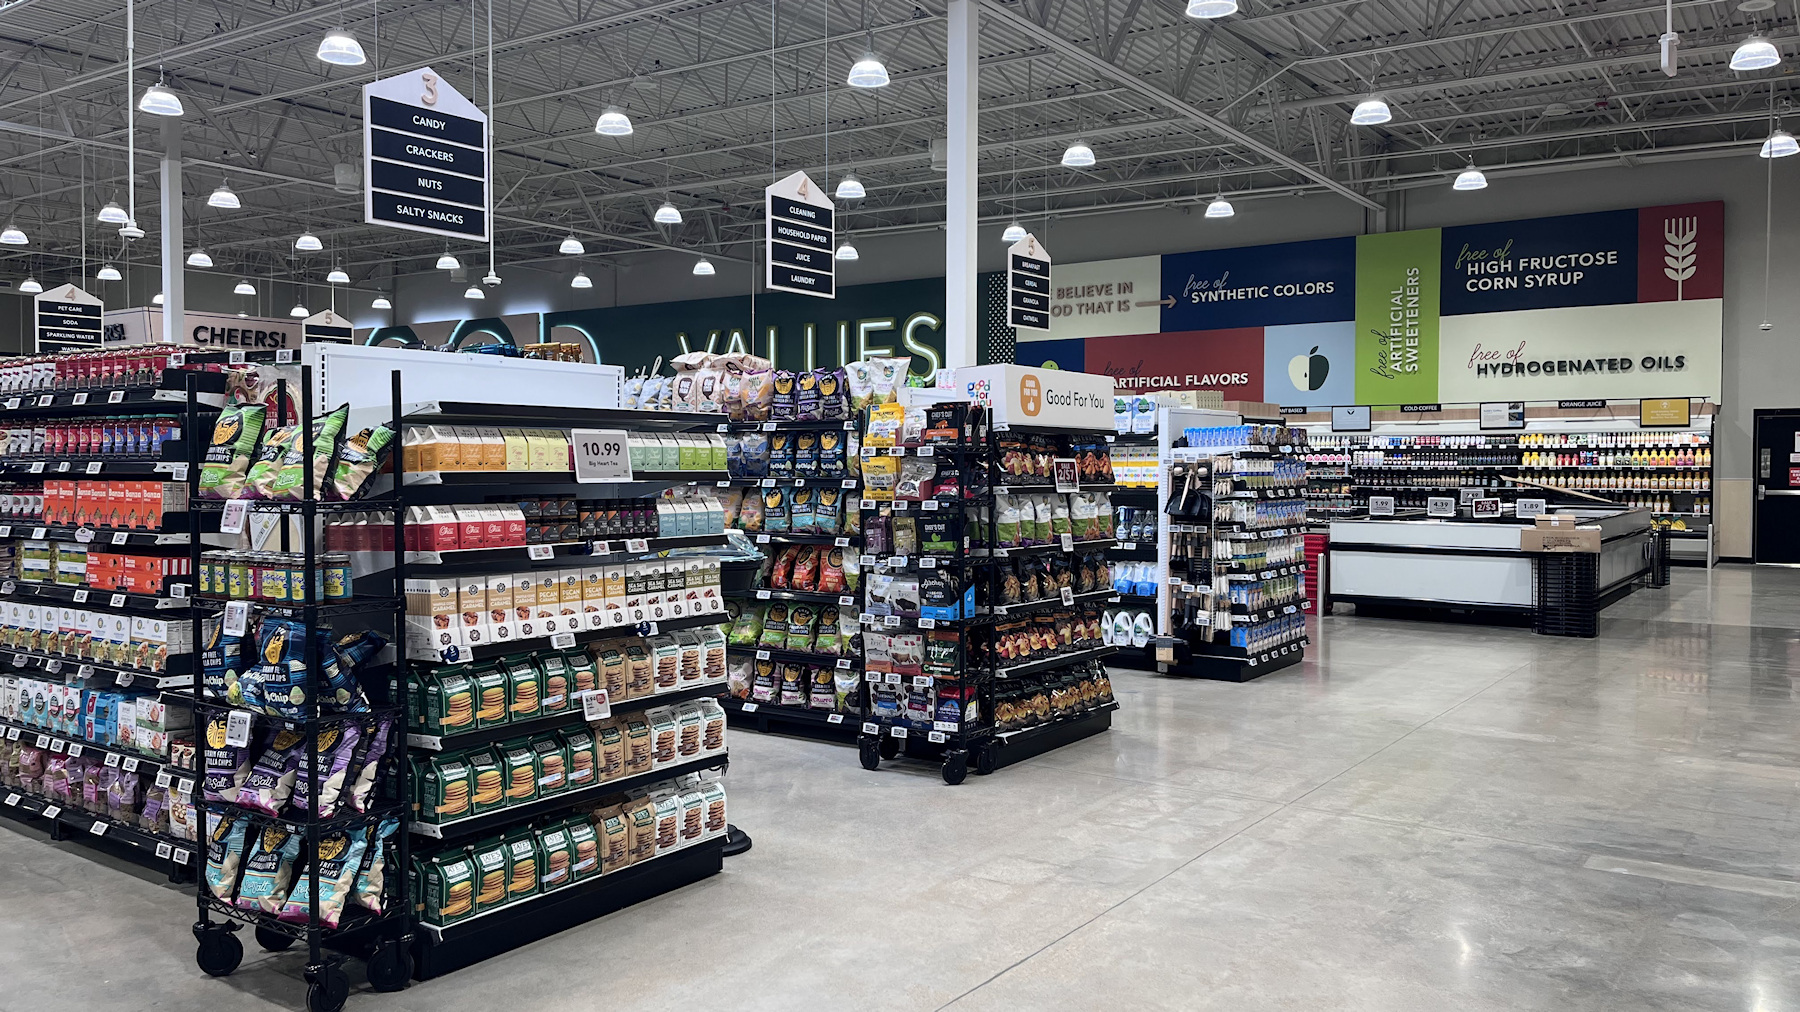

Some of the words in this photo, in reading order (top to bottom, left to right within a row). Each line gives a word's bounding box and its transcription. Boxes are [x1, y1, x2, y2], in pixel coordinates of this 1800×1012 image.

[421, 73, 439, 106] 3
[412, 115, 446, 131] CANDY
[405, 144, 454, 163] CRACKERS
[417, 177, 443, 190] NUTS
[797, 177, 809, 200] 4
[396, 204, 426, 218] SALTY
[427, 209, 464, 225] SNACKS
[789, 205, 816, 219] CLEANING
[778, 226, 810, 240] HOUSEHOLD
[811, 234, 827, 244] PAPER
[795, 253, 811, 262] JUICE
[1455, 243, 1489, 270] free
[1493, 239, 1513, 262] of
[1022, 261, 1040, 271] BREAKFAST
[1467, 259, 1512, 276] HIGH
[1519, 251, 1618, 272] FRUCTOSE
[790, 274, 816, 286] LAUNDRY
[1025, 280, 1037, 288] CEREAL
[1183, 273, 1210, 298] free
[1213, 271, 1229, 292] of
[1466, 276, 1518, 292] CORN
[1524, 271, 1584, 288] SYRUP
[1056, 283, 1113, 300] BELIEVE
[1117, 281, 1133, 294] IN
[1191, 286, 1270, 303] SYNTHETIC
[1273, 281, 1335, 297] COLORS
[1051, 304, 1073, 318] OD
[1076, 300, 1114, 315] THAT
[1117, 299, 1131, 312] IS
[325, 312, 332, 324] 5
[1405, 267, 1419, 372] SWEETENERS
[192, 325, 287, 349] CHEERS!
[1370, 329, 1395, 346] of
[1390, 286, 1403, 372] ARTIFICIAL
[1468, 343, 1502, 368] free
[1506, 340, 1526, 366] of
[1129, 360, 1144, 377] of
[1370, 350, 1395, 379] free
[1477, 357, 1633, 376] HYDROGENATED
[1641, 355, 1685, 371] OILS
[967, 379, 991, 398] good
[1026, 380, 1036, 388] GOOD
[1113, 375, 1181, 389] ARTIFICIAL
[1185, 372, 1249, 387] FLAVORS
[975, 391, 989, 400] for
[1046, 389, 1071, 406] Good
[1074, 392, 1087, 407] For
[1089, 393, 1105, 408] You
[582, 442, 620, 456] 10.99
[217, 750, 228, 758] FREE
[254, 775, 273, 787] Salt
[511, 840, 530, 850] TATE'S
[545, 833, 563, 842] TATE'S
[319, 861, 334, 870] FREE
[482, 852, 501, 862] TATE'S
[319, 868, 337, 877] CHIPS
